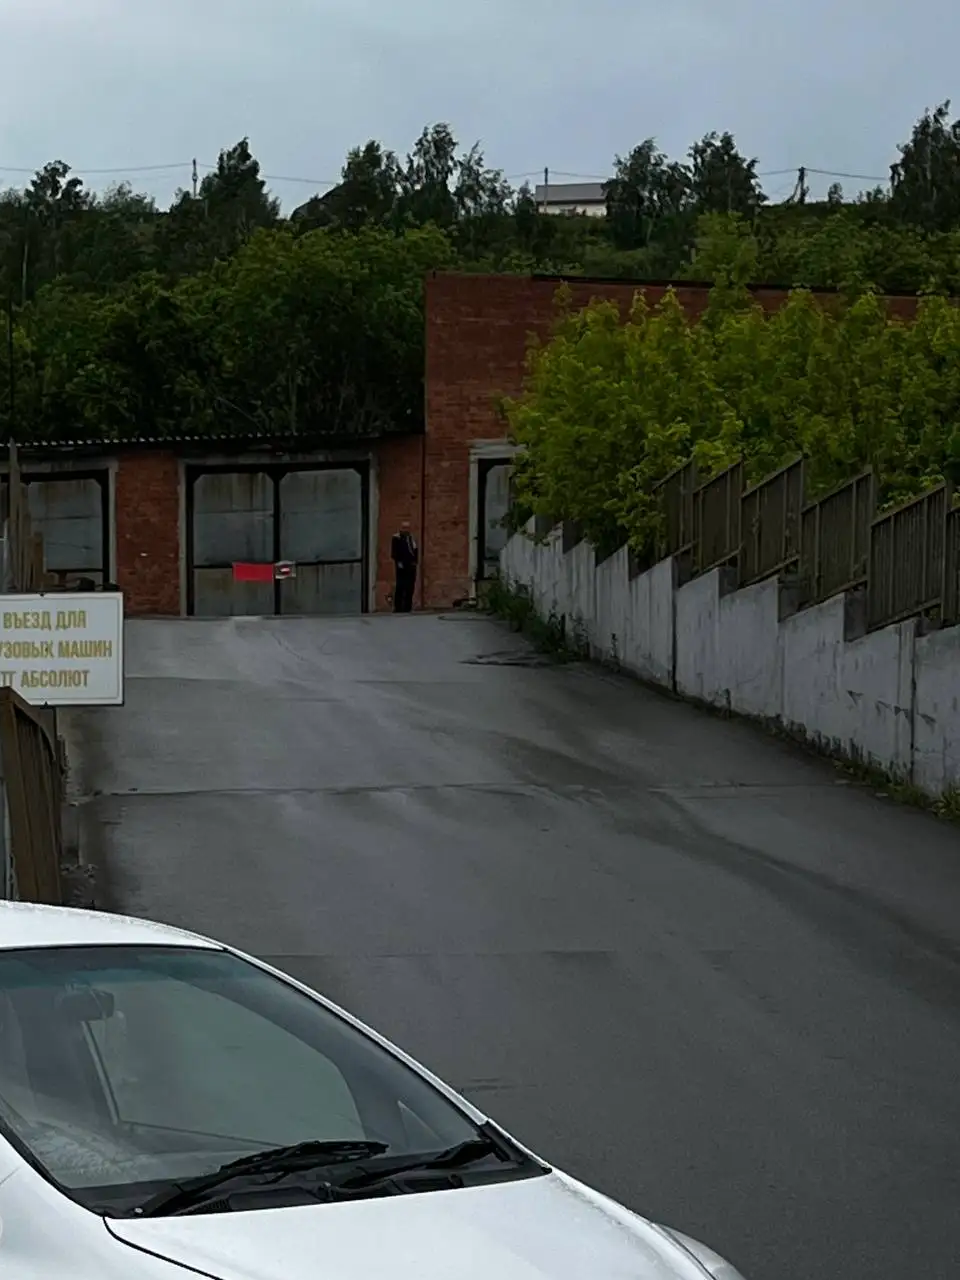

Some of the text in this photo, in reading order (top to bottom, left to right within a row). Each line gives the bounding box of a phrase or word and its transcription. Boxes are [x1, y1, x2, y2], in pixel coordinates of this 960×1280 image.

[2, 610, 87, 631] ВЪЕЗД ДЛЯ
[58, 640, 113, 659] МАШИН
[20, 669, 91, 688] АБСОЛЮТ
